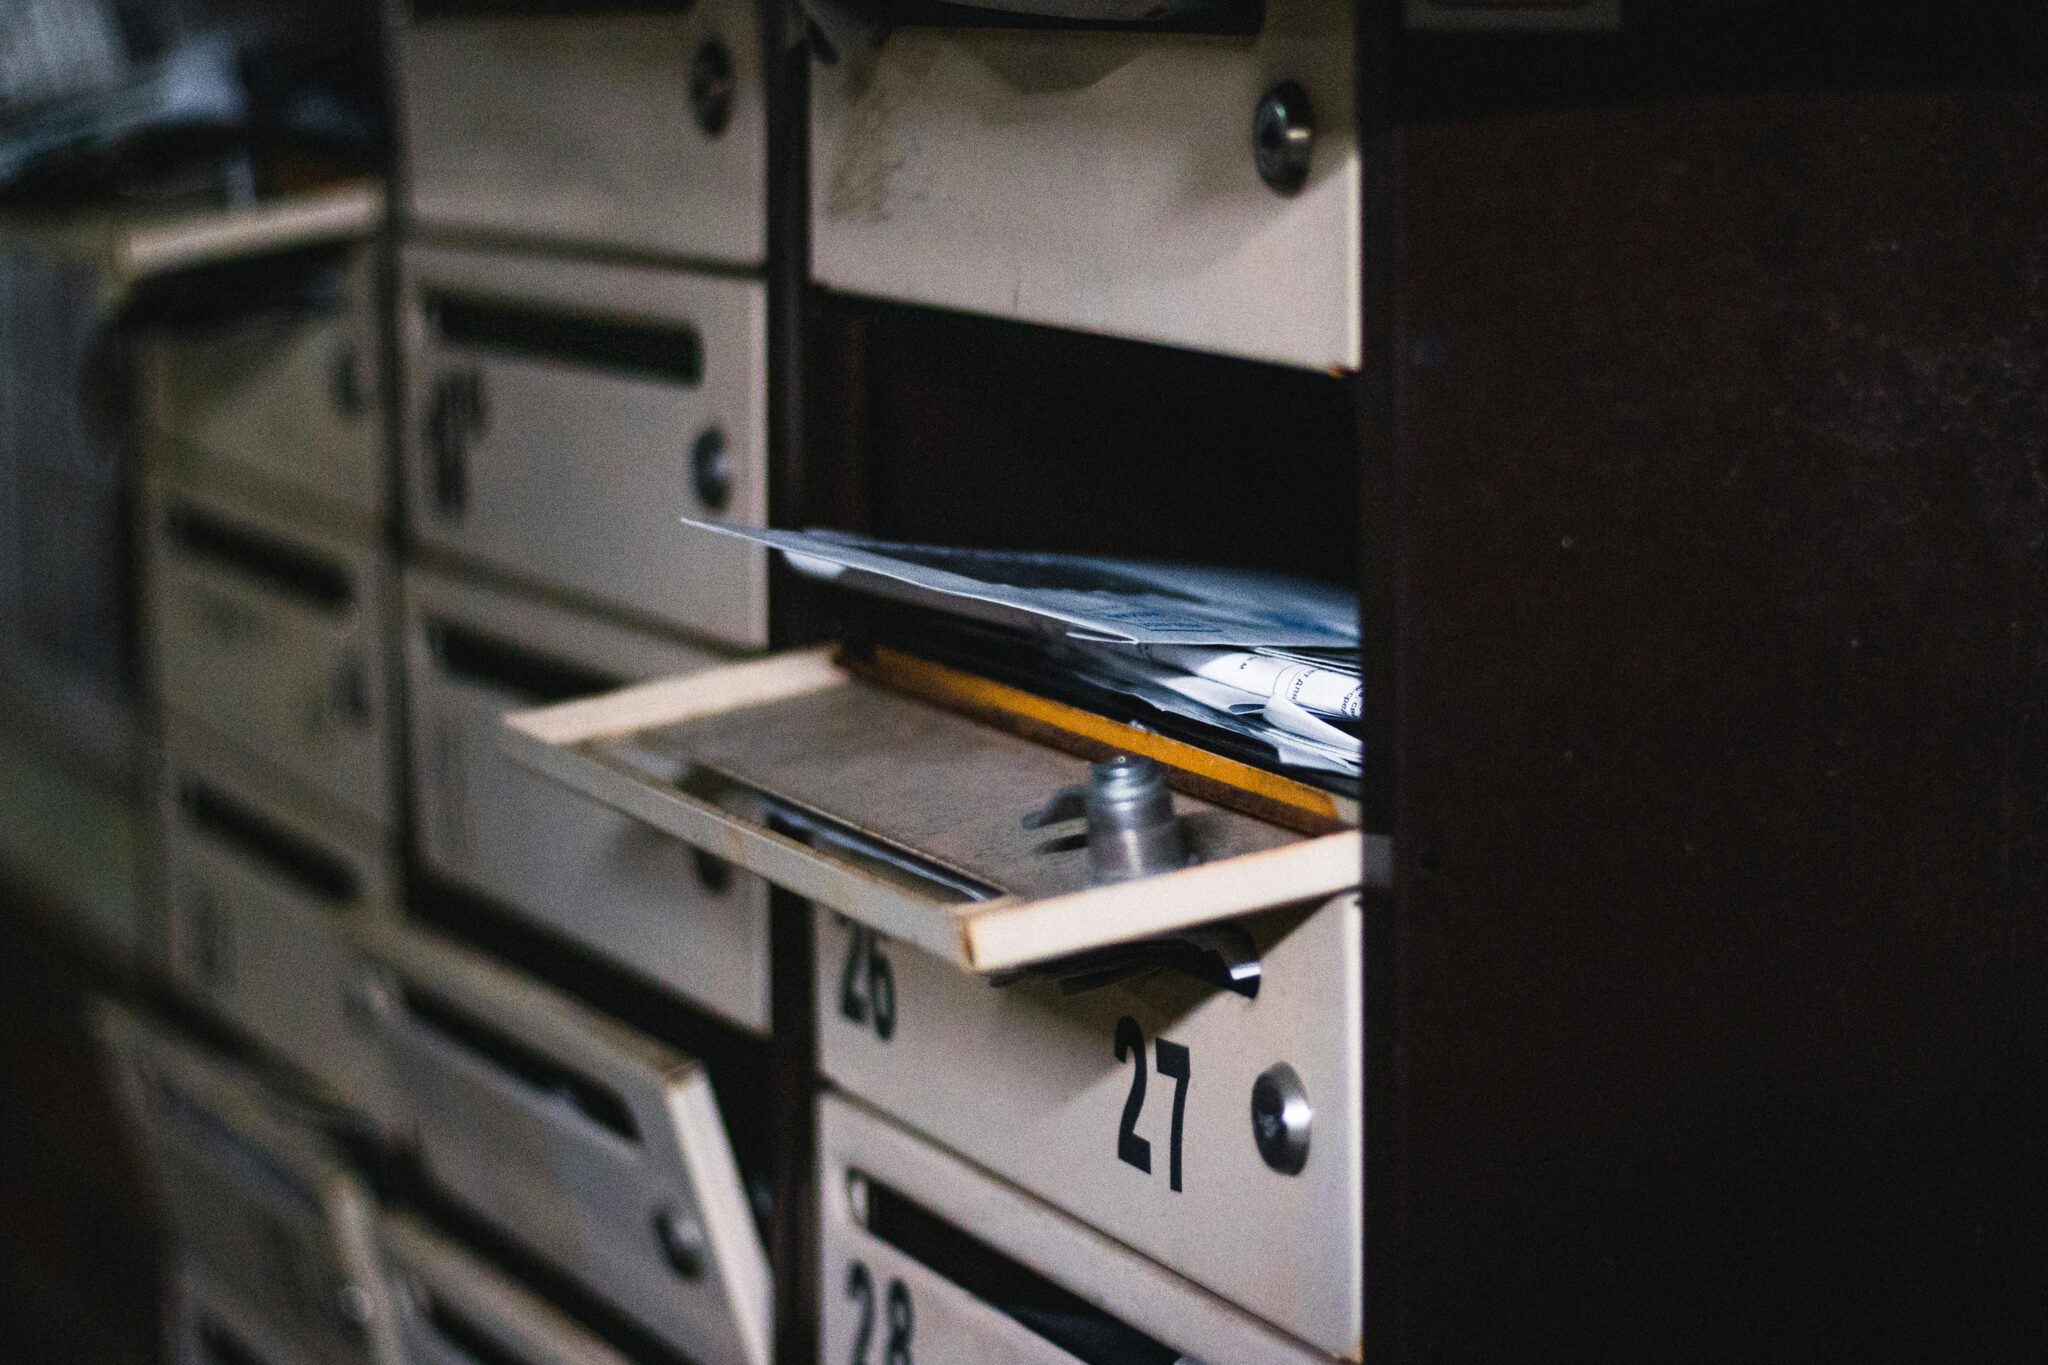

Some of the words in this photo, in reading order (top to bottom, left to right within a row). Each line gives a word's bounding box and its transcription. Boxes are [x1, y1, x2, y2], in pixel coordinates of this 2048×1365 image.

[834, 911, 897, 1041] 26
[1113, 1015, 1192, 1194] 27
[846, 1258, 915, 1365] 28
